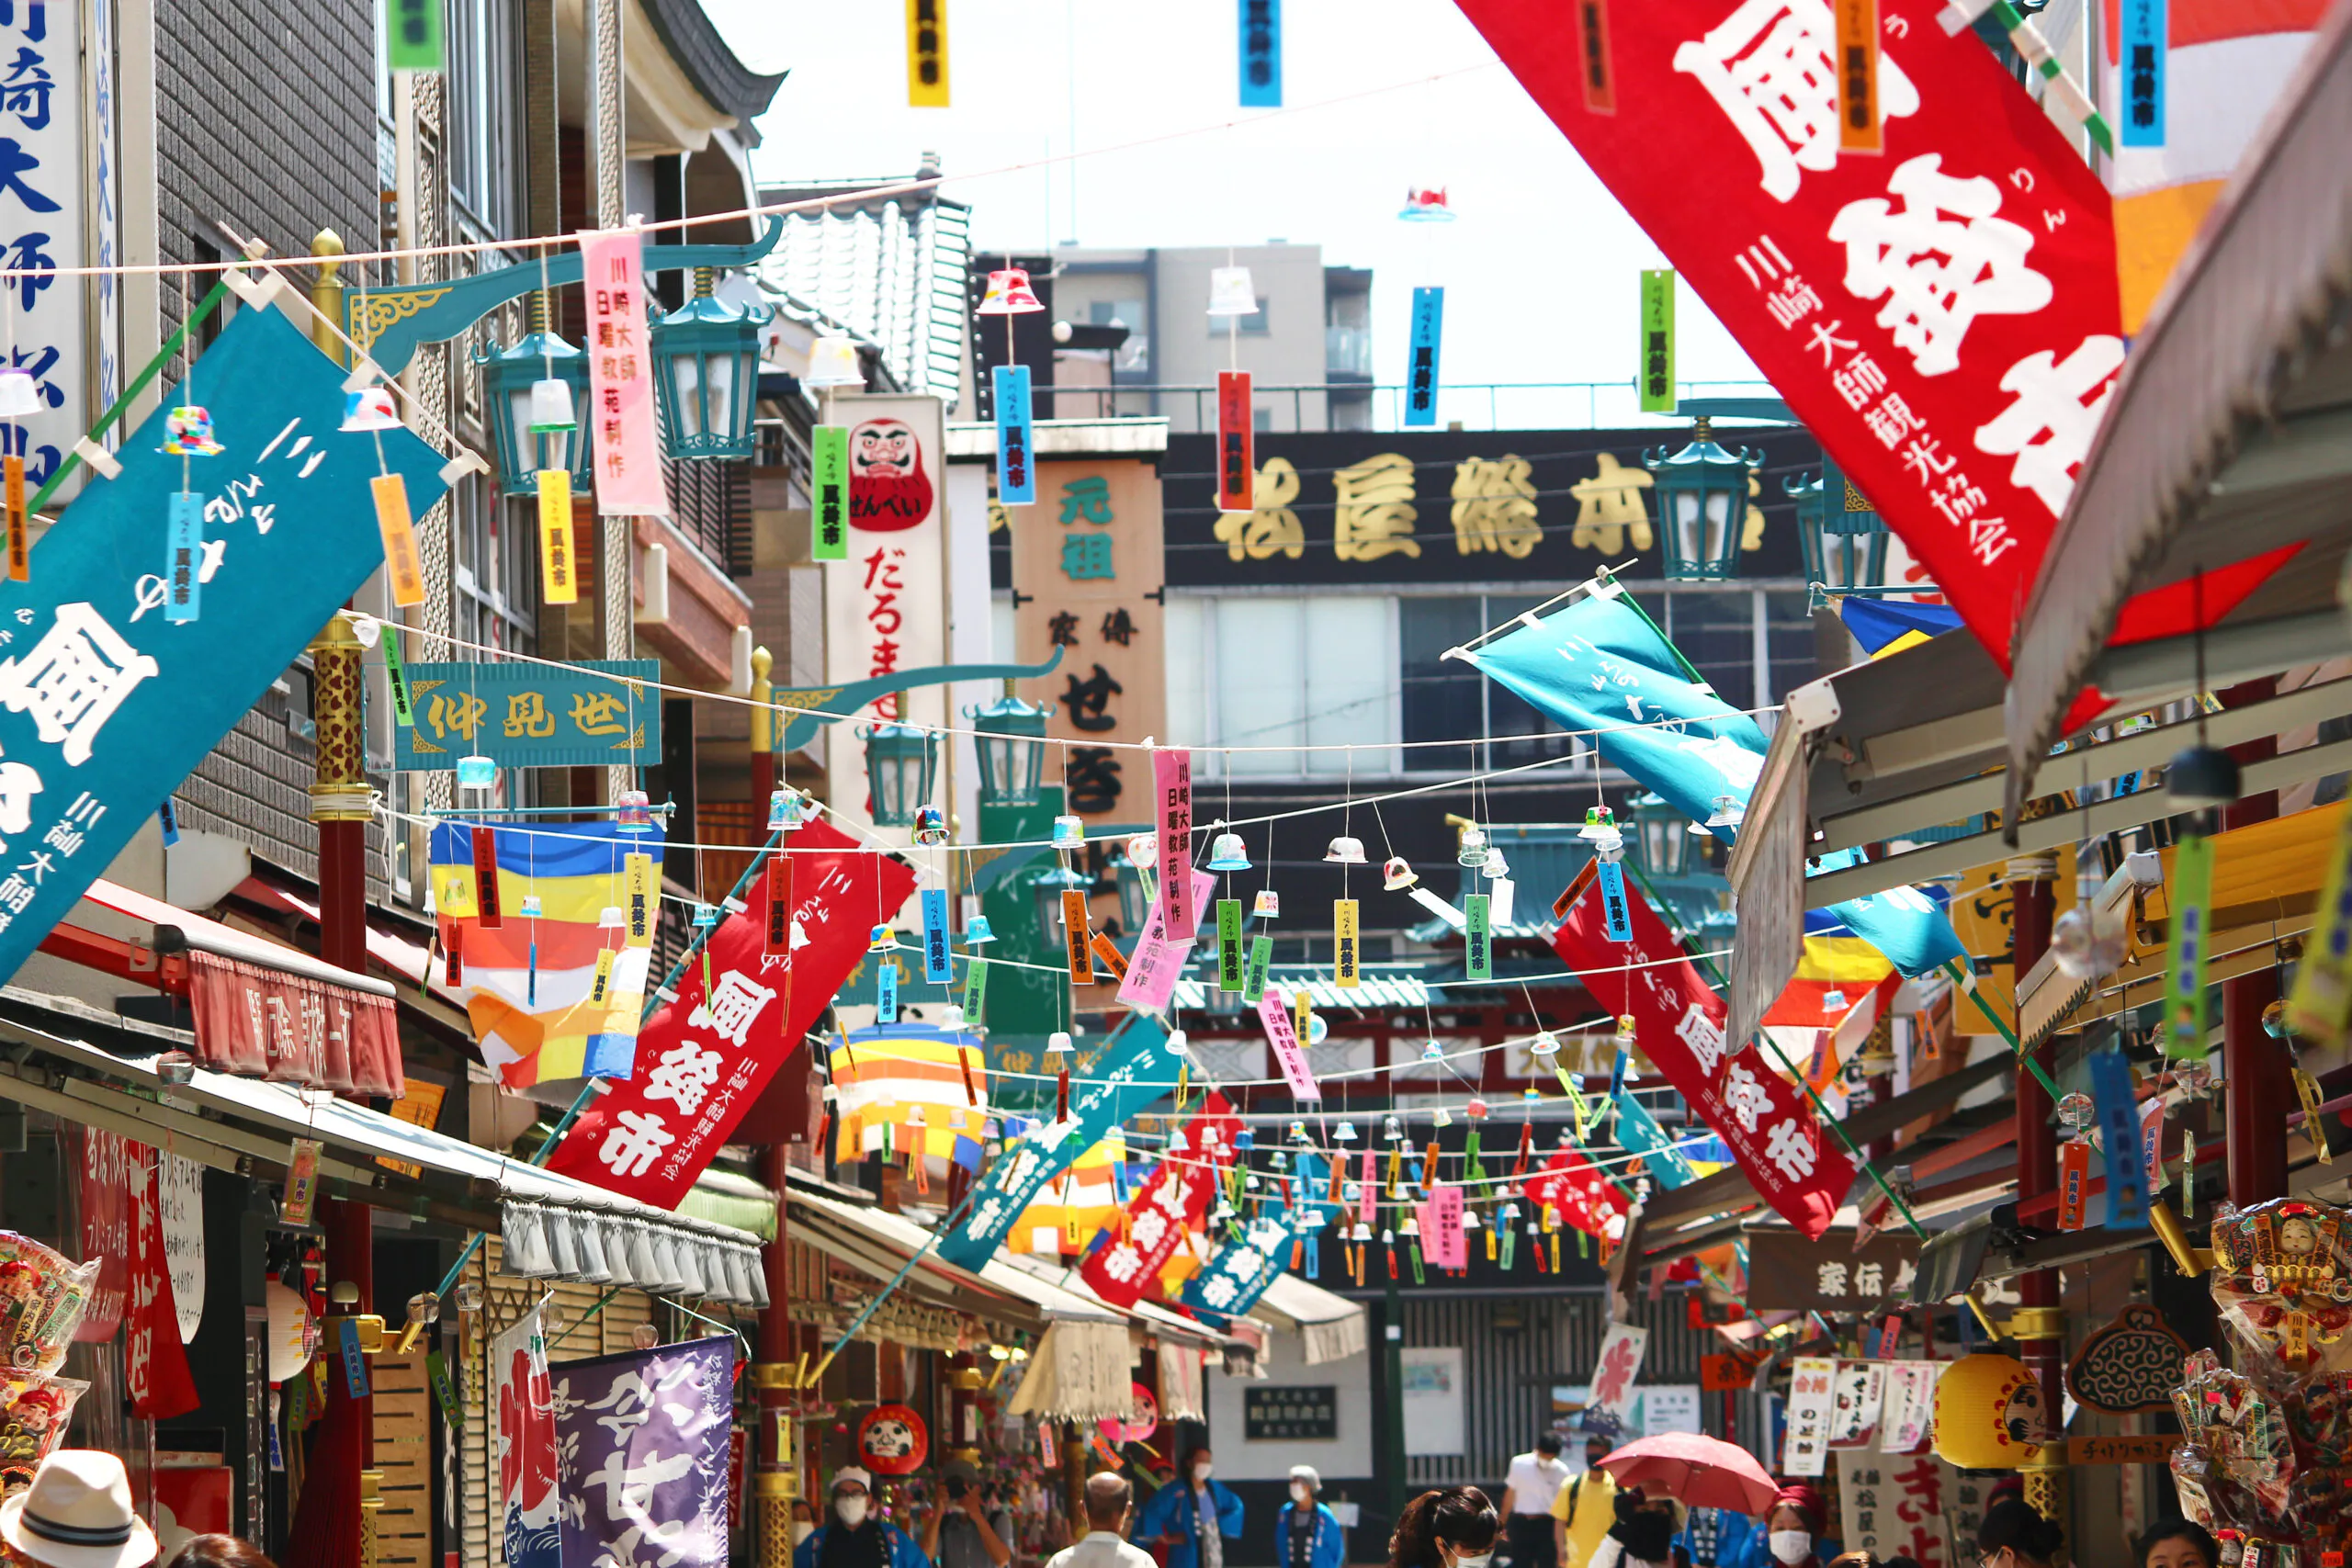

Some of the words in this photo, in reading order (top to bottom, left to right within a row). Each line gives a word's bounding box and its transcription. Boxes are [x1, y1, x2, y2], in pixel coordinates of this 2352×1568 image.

[610, 256, 637, 382] 川崎大師
[1735, 233, 2018, 567] 川崎大師観光協会
[1004, 425, 1027, 490] 風鈴市
[821, 484, 841, 546] 風鈴市
[1058, 474, 1115, 581] 元祖
[1213, 451, 1765, 563] 松屋総本
[426, 691, 628, 741] 仲見世
[1178, 763, 1190, 852] 川崎大師
[1167, 788, 1182, 923] 日曜教苑制作
[631, 893, 646, 938] 風鈴市
[1608, 896, 1626, 933] 風鈴市
[928, 929, 945, 973] 風鈴市
[1071, 931, 1087, 975] 風鈴市
[1224, 939, 1238, 983] 風鈴市
[1340, 937, 1354, 978] 風鈴市
[1470, 931, 1485, 971] 風鈴市
[593, 974, 606, 1002] 風鈴市
[882, 989, 893, 1016] 風鈴市
[967, 987, 979, 1018] 風鈴市
[1250, 964, 1264, 996] 風鈴市
[1272, 999, 1297, 1051] 川崎大師
[1674, 1001, 1816, 1183] 風鈴市
[2144, 1127, 2156, 1166] 風鈴市
[2067, 1170, 2080, 1204] 風鈴市
[11, 1298, 42, 1347] 家内安全
